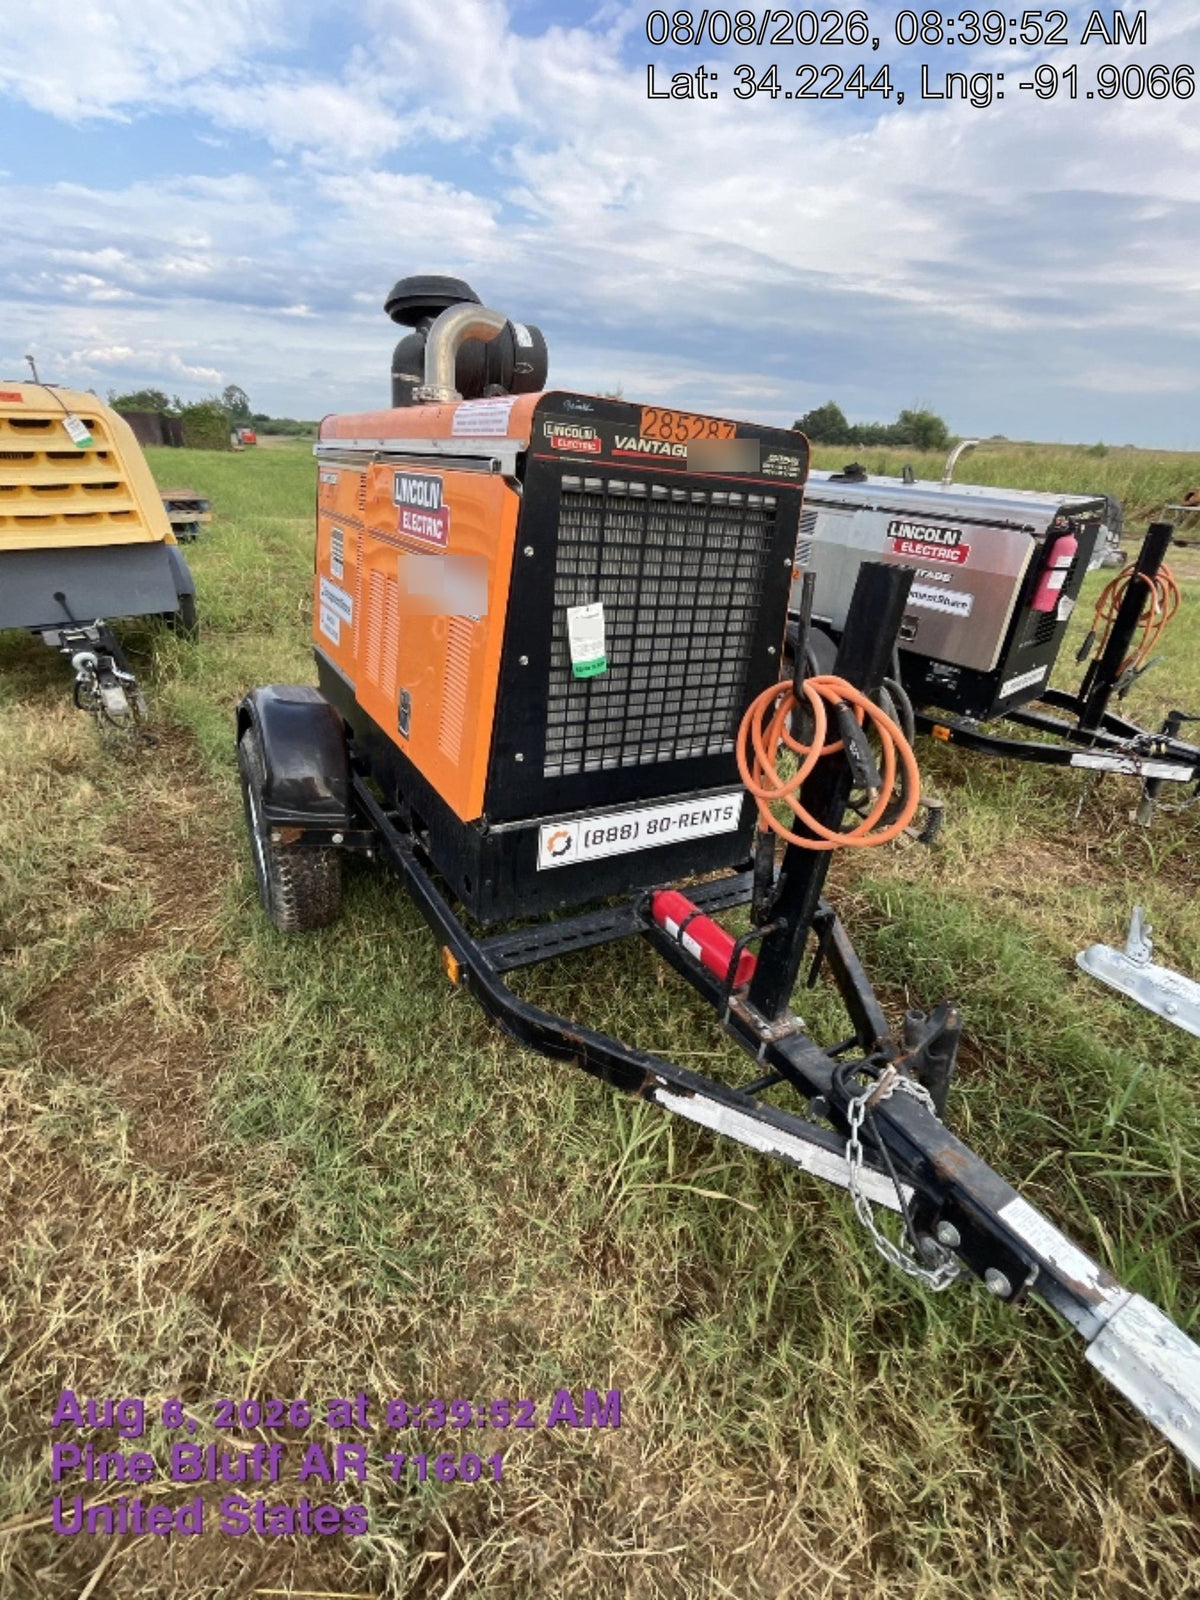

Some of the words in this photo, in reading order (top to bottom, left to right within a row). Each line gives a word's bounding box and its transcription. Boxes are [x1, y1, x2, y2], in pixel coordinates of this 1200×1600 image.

[546, 423, 594, 440] LINCOLN
[395, 477, 441, 510] LINCOLN
[402, 511, 443, 540] ELECTRIC
[890, 522, 958, 545] LINCOLN
[900, 541, 962, 561] ELECTRIC
[584, 822, 640, 848] (888)
[646, 806, 734, 834] 80-RENTS
